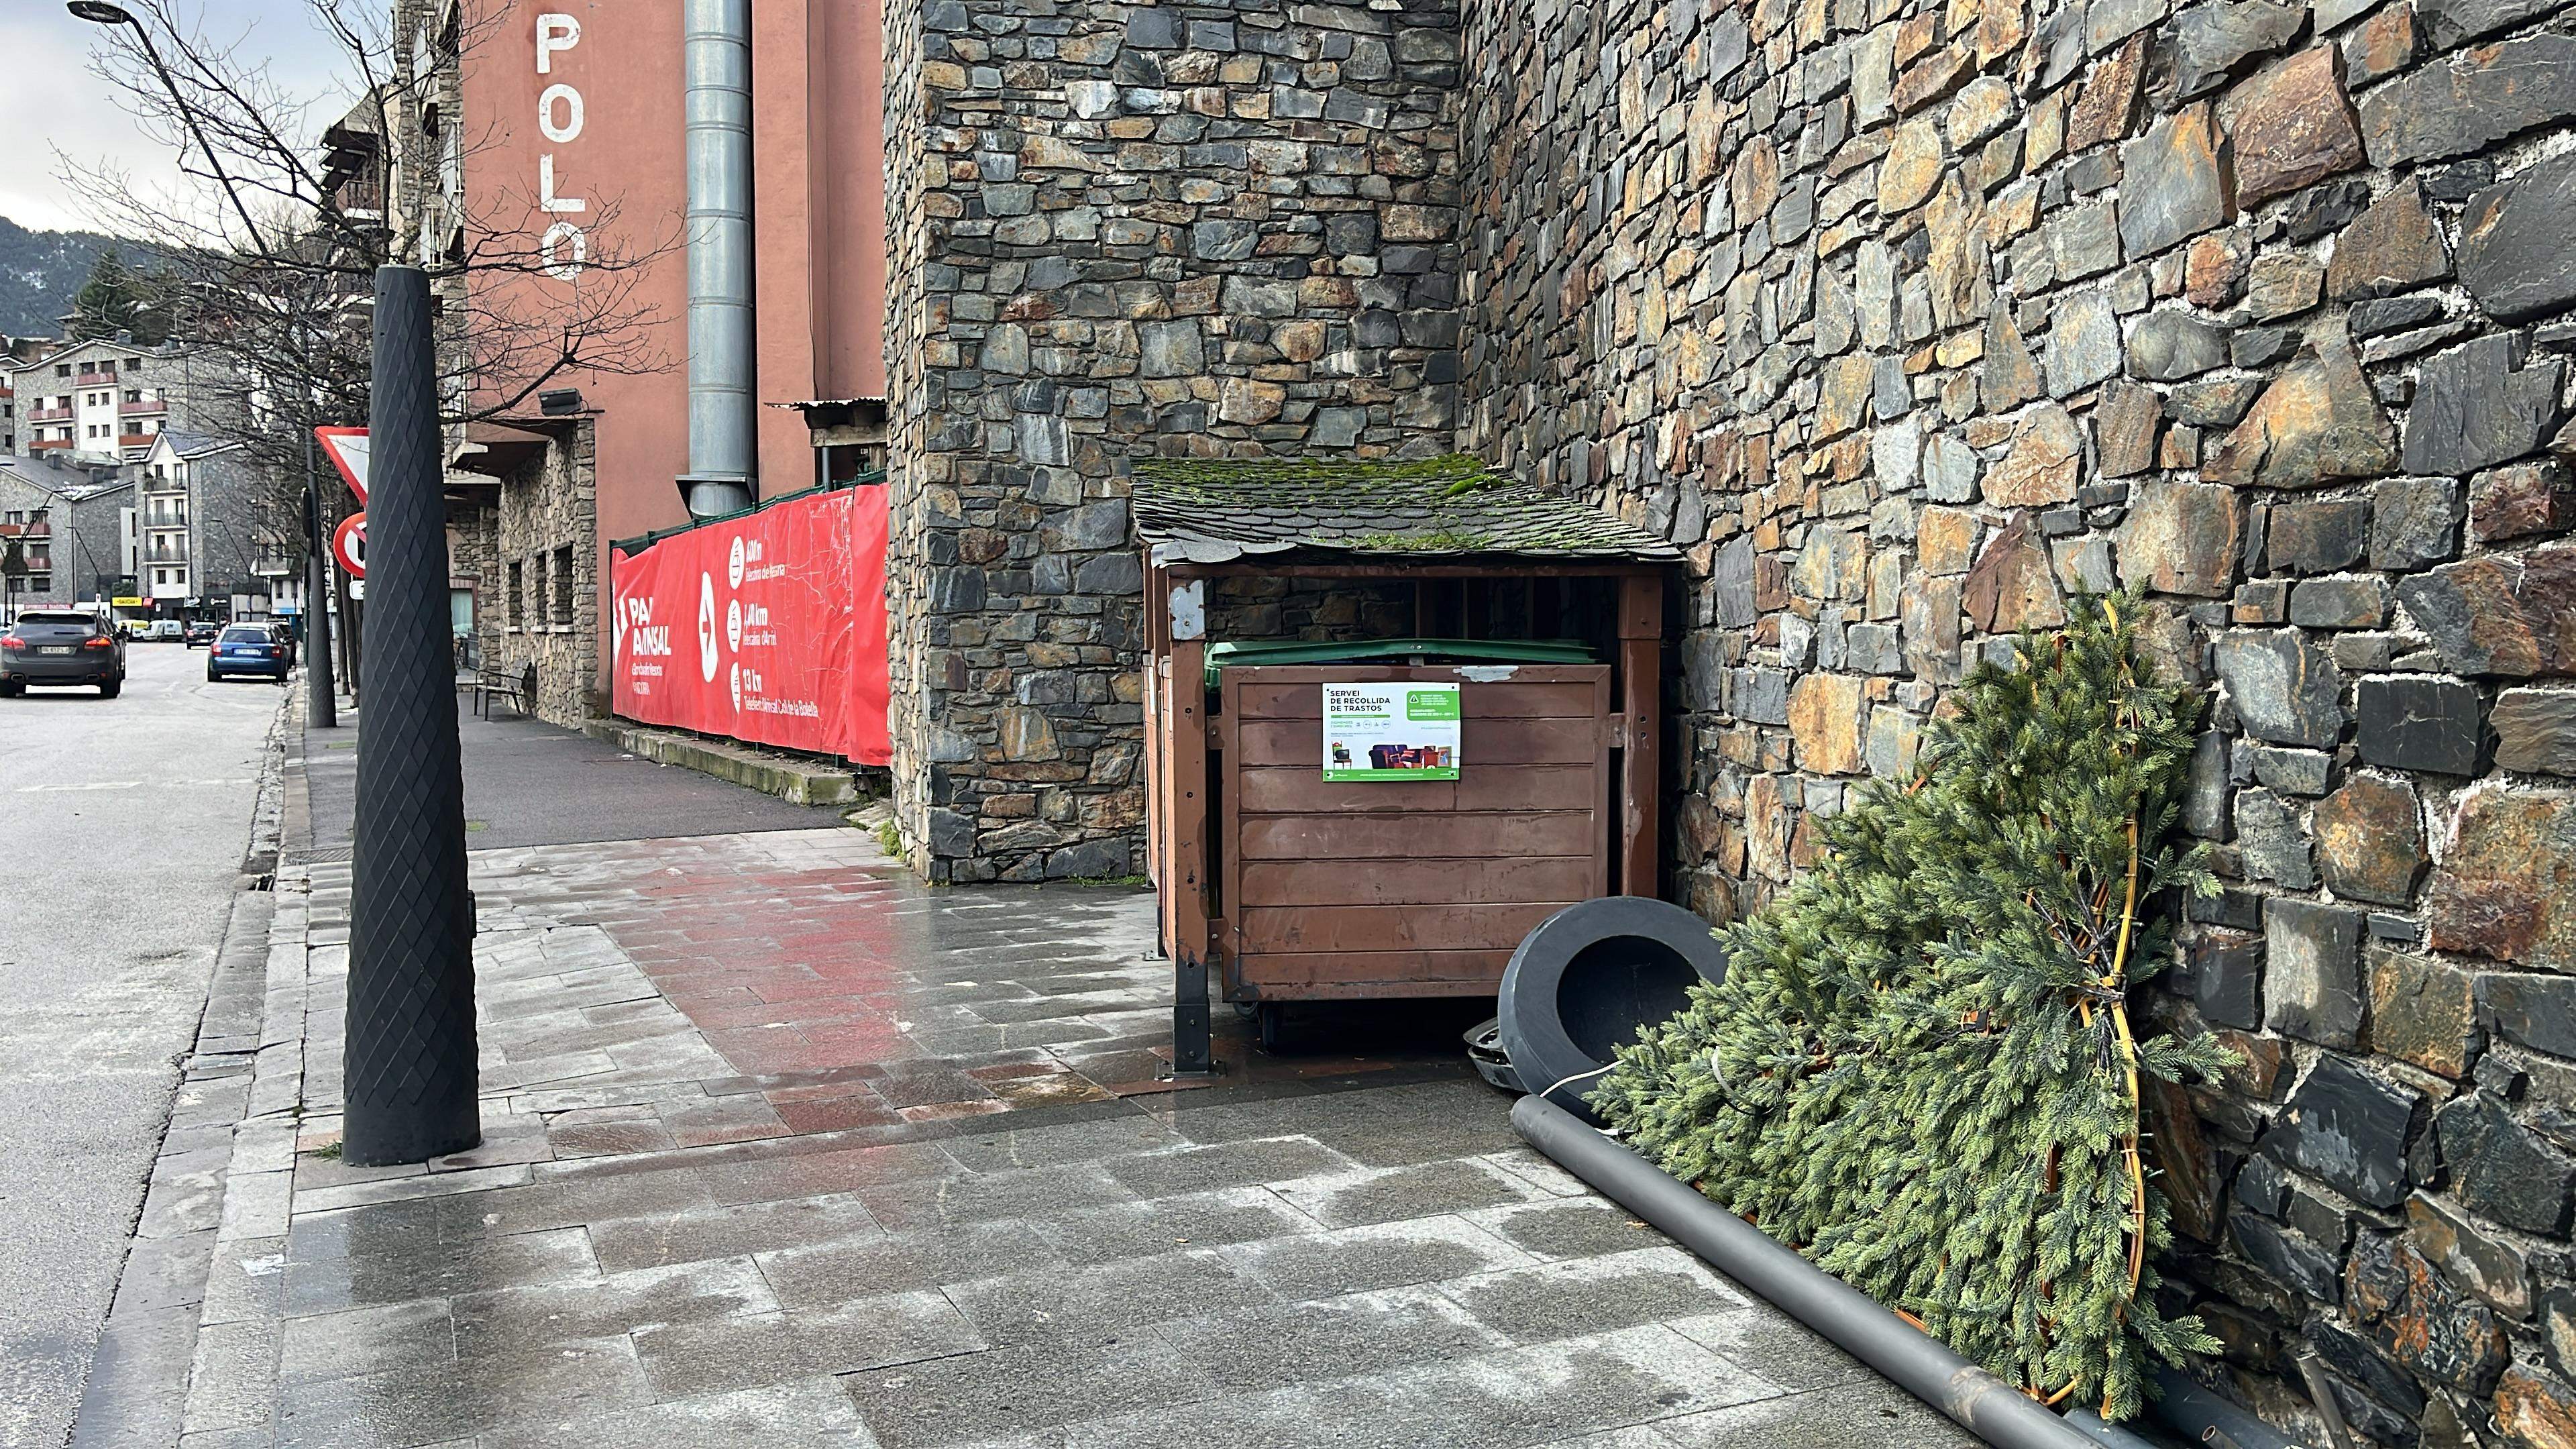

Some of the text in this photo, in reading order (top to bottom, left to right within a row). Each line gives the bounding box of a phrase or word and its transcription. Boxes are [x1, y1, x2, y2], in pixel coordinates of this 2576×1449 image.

[536, 13, 587, 282] POLO
[755, 603, 768, 627] km
[743, 668, 751, 692] 13
